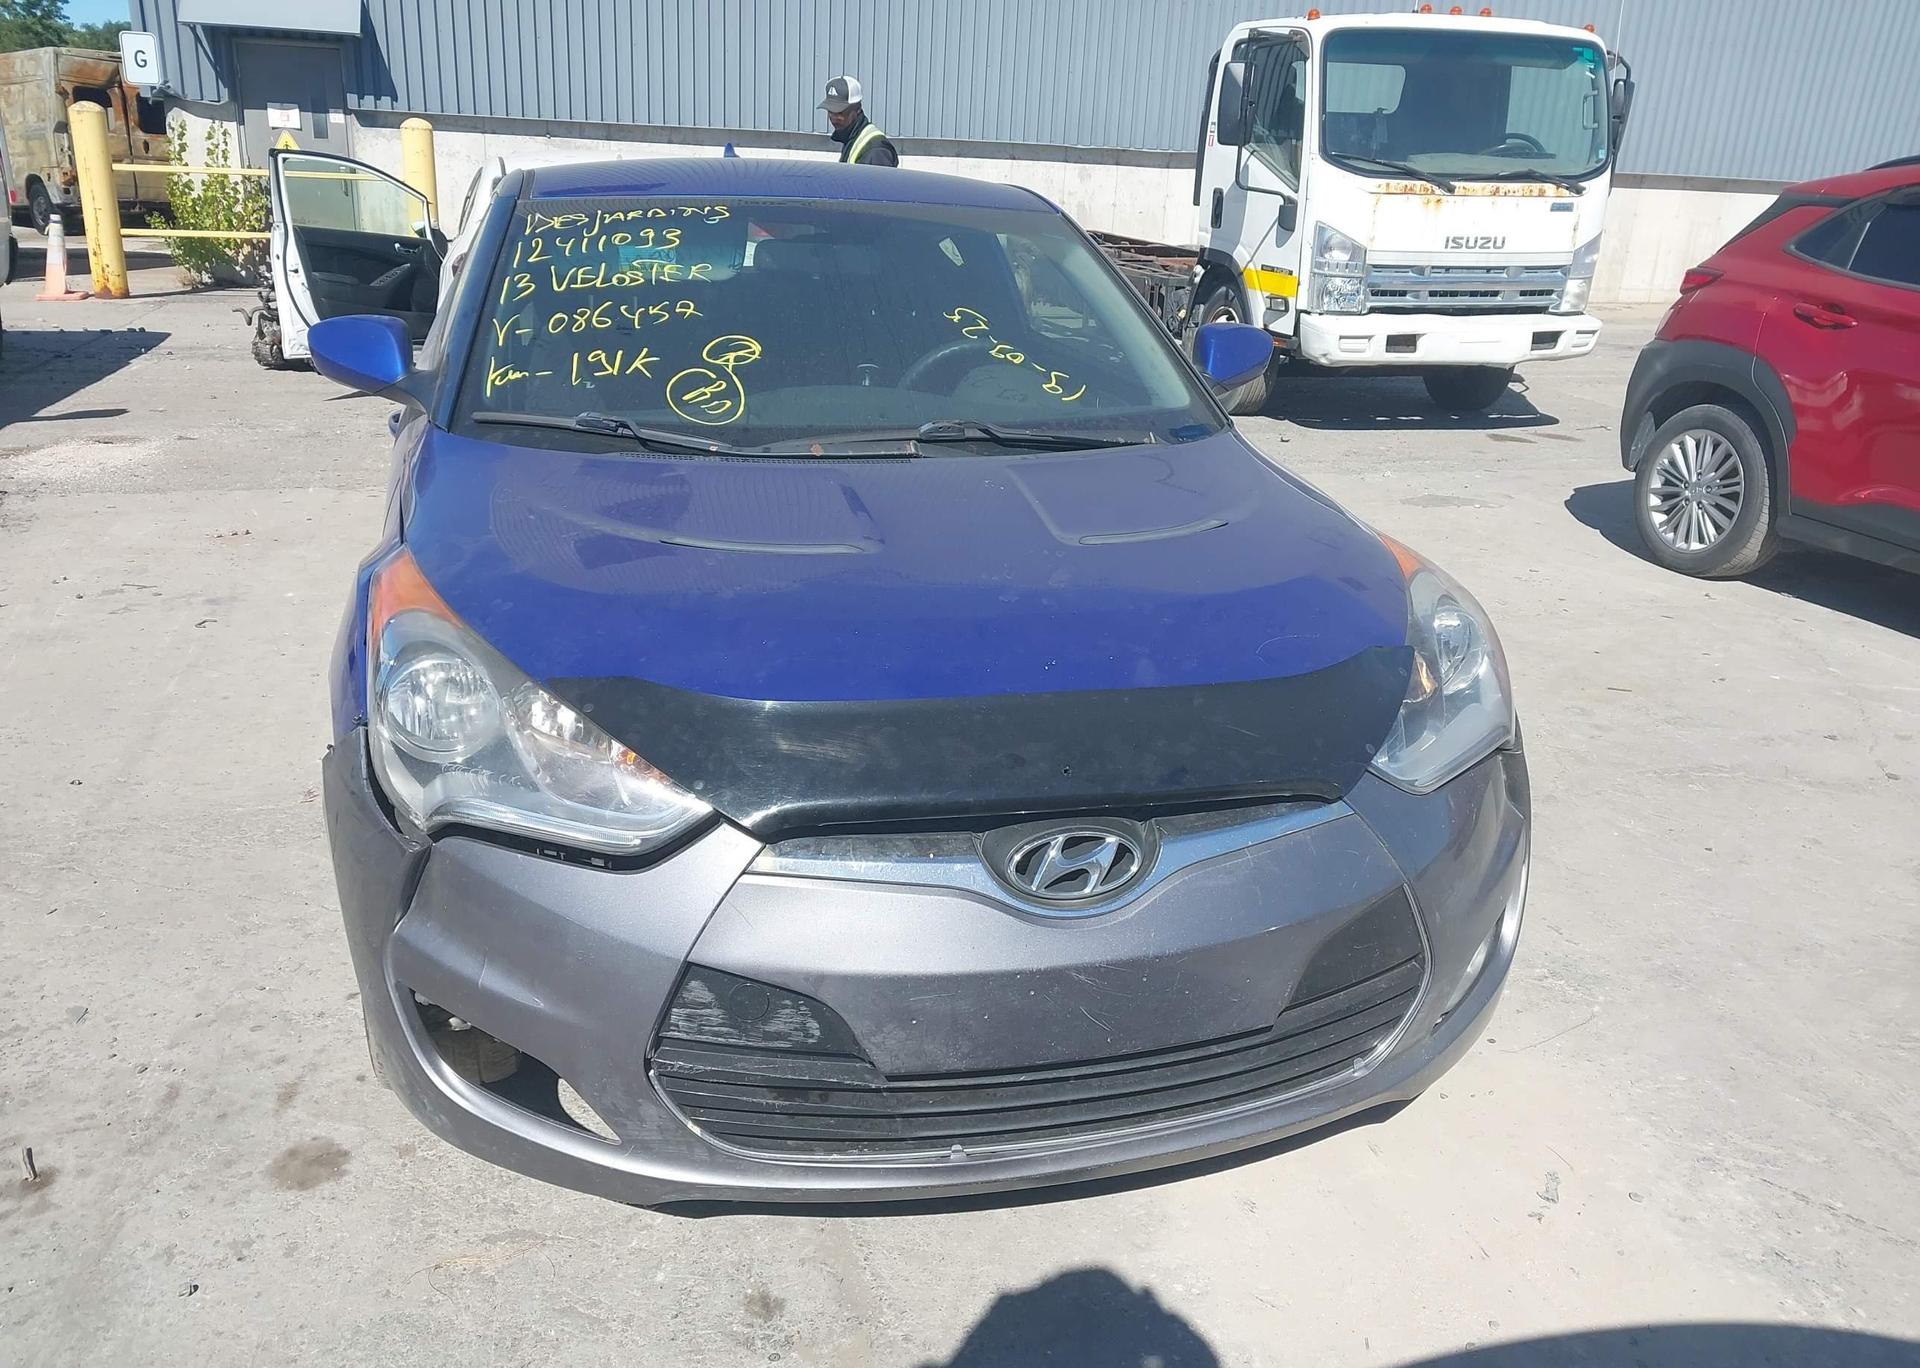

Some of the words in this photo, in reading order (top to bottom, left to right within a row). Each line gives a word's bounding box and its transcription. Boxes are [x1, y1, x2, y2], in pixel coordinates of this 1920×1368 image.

[134, 50, 148, 68] G
[1444, 235, 1506, 250] ISUZU
[500, 273, 536, 305] 13
[550, 258, 713, 292] VELOSTER
